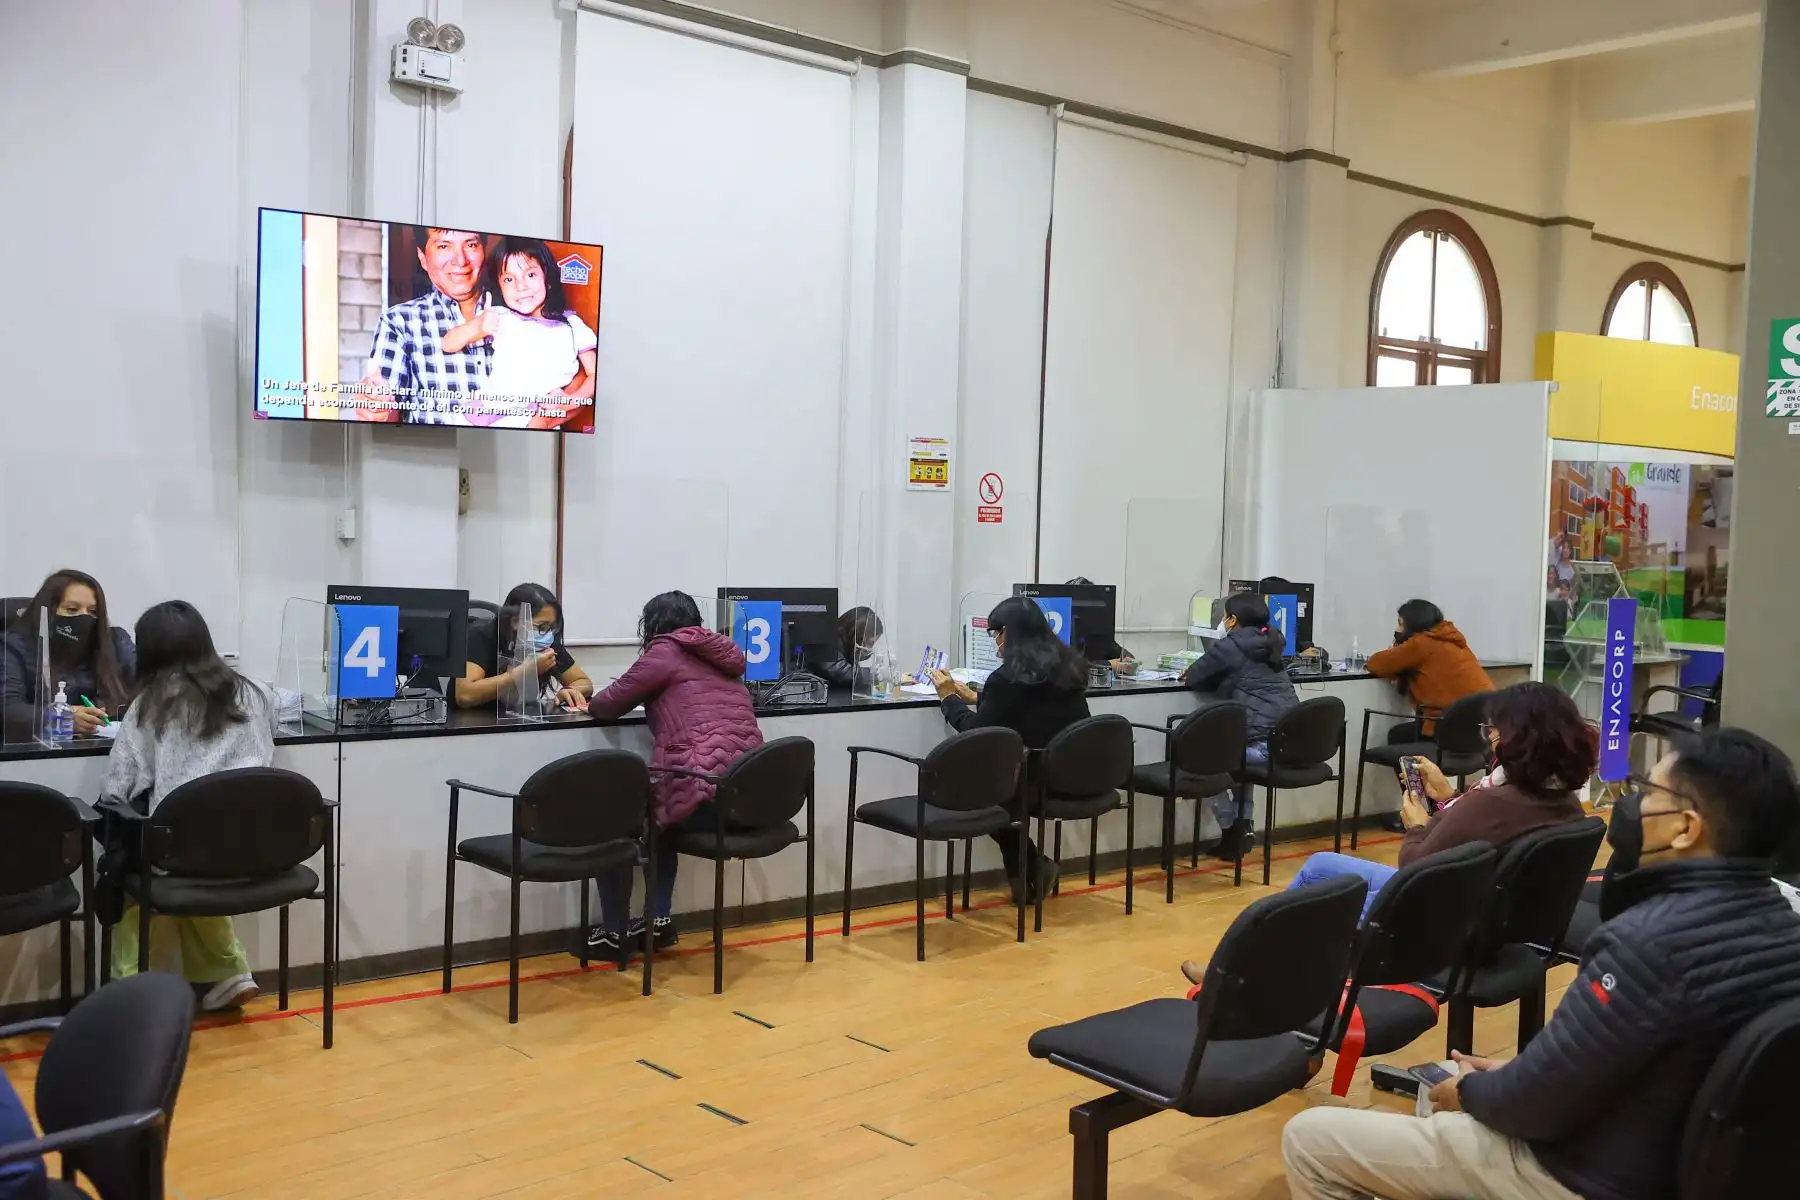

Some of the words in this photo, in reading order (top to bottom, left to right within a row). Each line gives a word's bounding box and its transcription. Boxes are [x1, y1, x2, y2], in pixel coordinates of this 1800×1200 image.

[562, 272, 587, 281] propio
[262, 394, 314, 407] dependa
[319, 396, 416, 411] económicamente
[420, 401, 435, 412] de
[452, 404, 473, 414] con
[477, 406, 536, 418] parentesco
[537, 407, 567, 418] hasta
[263, 379, 279, 390] Un
[284, 381, 308, 392] Jefe
[313, 382, 327, 392] de
[331, 383, 372, 395] Familia
[376, 383, 417, 397] declara
[421, 387, 463, 400] mínimo
[466, 389, 475, 401] al
[478, 391, 514, 403] menos
[518, 394, 532, 404] un
[534, 393, 572, 405] familiar
[573, 397, 593, 406] que
[334, 593, 361, 601] Lenovo
[1274, 607, 1287, 638] 1
[343, 626, 386, 677] 4
[742, 617, 771, 663] 3
[1607, 629, 1625, 751] ENACORP
